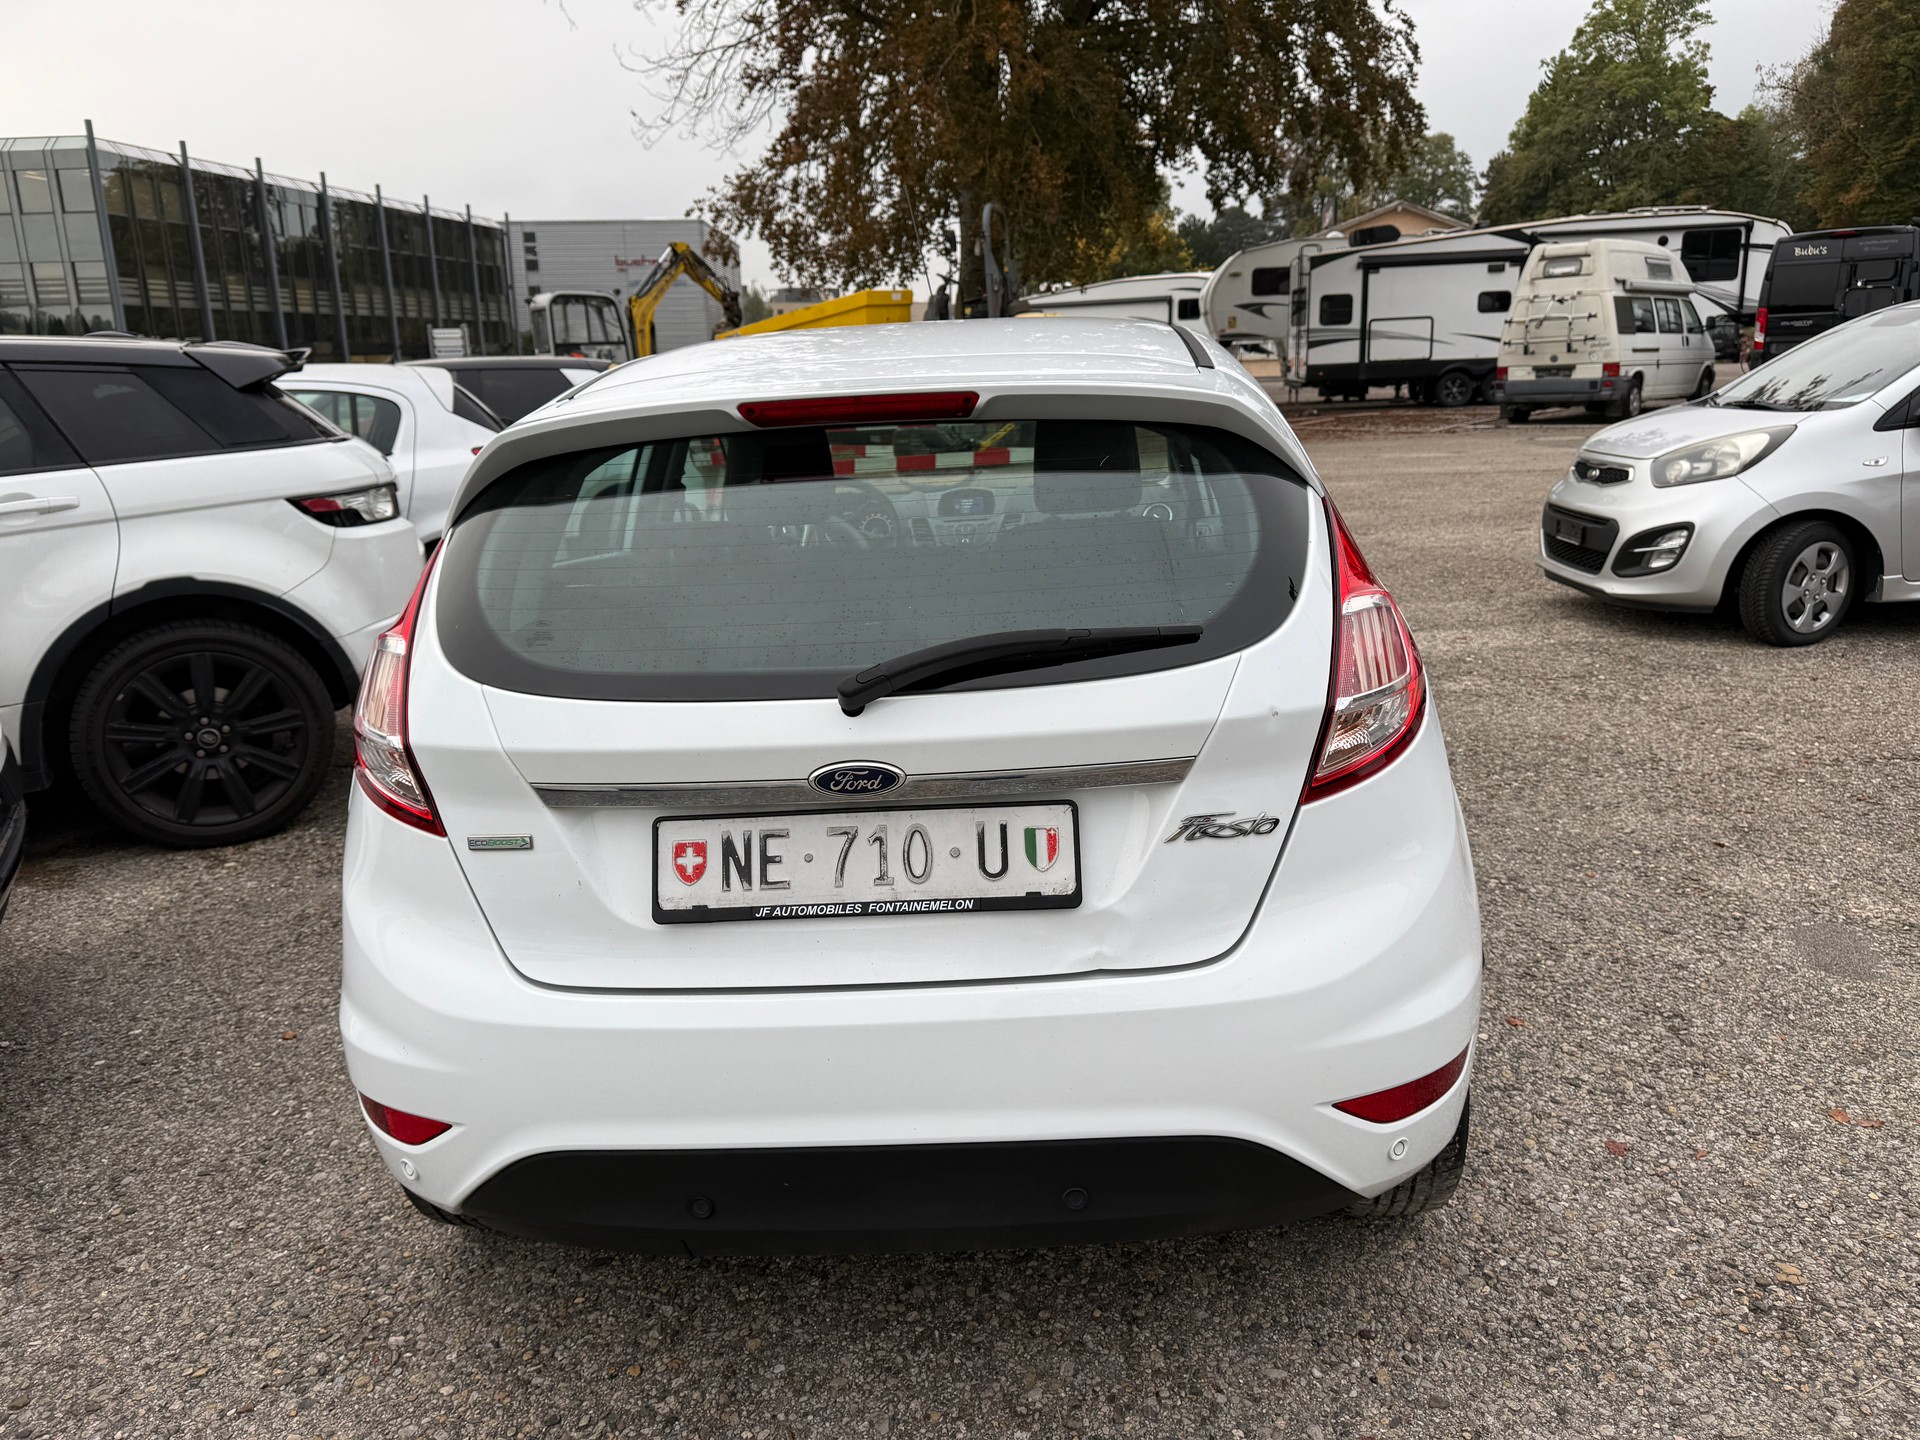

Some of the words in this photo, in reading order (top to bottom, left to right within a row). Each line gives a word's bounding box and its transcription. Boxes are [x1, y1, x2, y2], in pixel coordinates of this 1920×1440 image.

[830, 770, 882, 791] Ford
[1163, 808, 1280, 844] Fiesta
[721, 828, 790, 892] NE
[826, 823, 933, 887] 710
[975, 820, 1009, 882] U
[755, 907, 770, 917] JF
[772, 903, 862, 917] AUTOMOBILES
[868, 899, 974, 914] FONTAINEMELON
